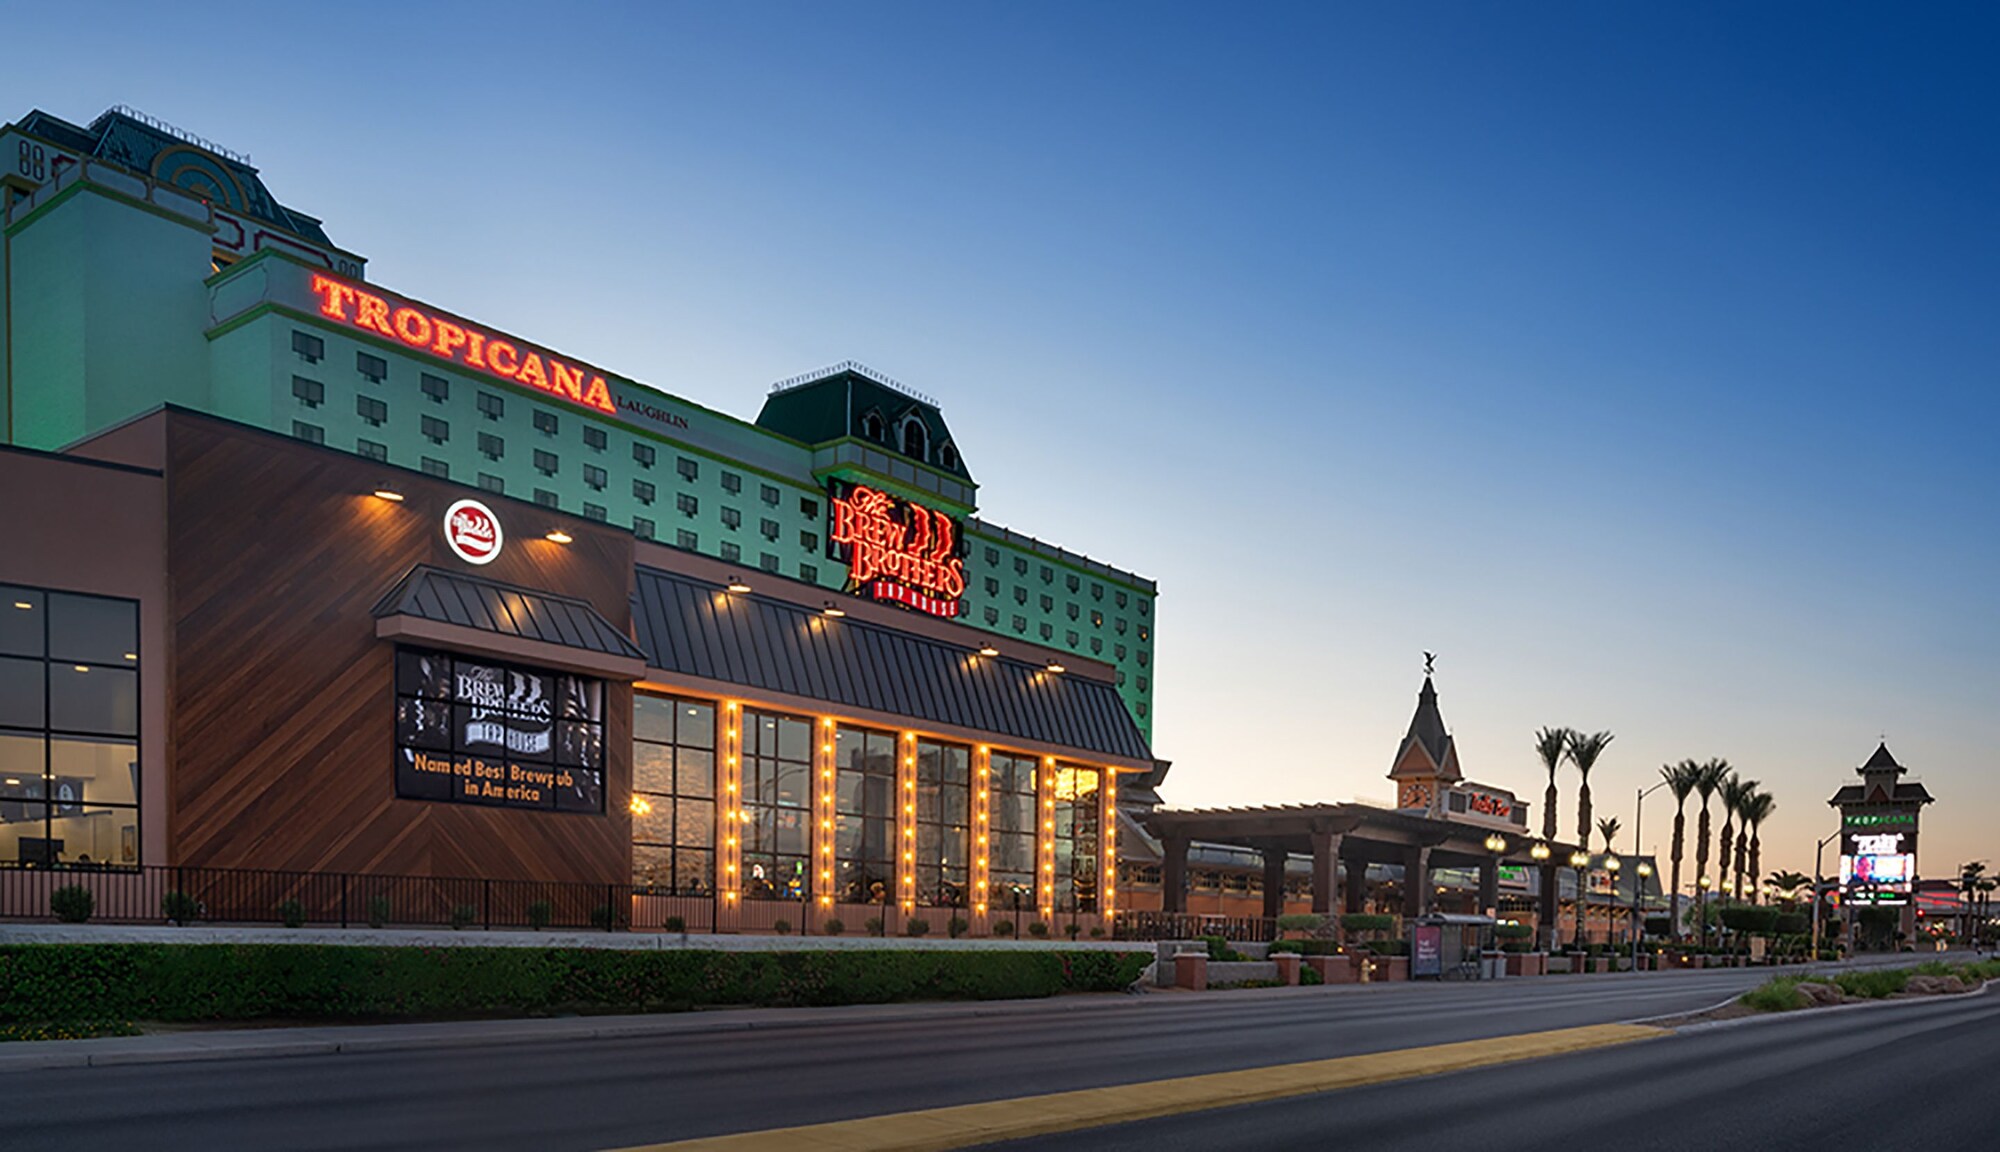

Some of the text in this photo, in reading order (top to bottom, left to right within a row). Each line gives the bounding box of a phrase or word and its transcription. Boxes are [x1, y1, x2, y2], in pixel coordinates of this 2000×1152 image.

[313, 274, 617, 415] TROPICANA
[617, 395, 689, 429] LAUGHLIN
[850, 537, 964, 597] BROTHERS
[414, 753, 472, 776] Named
[511, 764, 574, 789] Brewpub
[465, 779, 541, 801] in America
